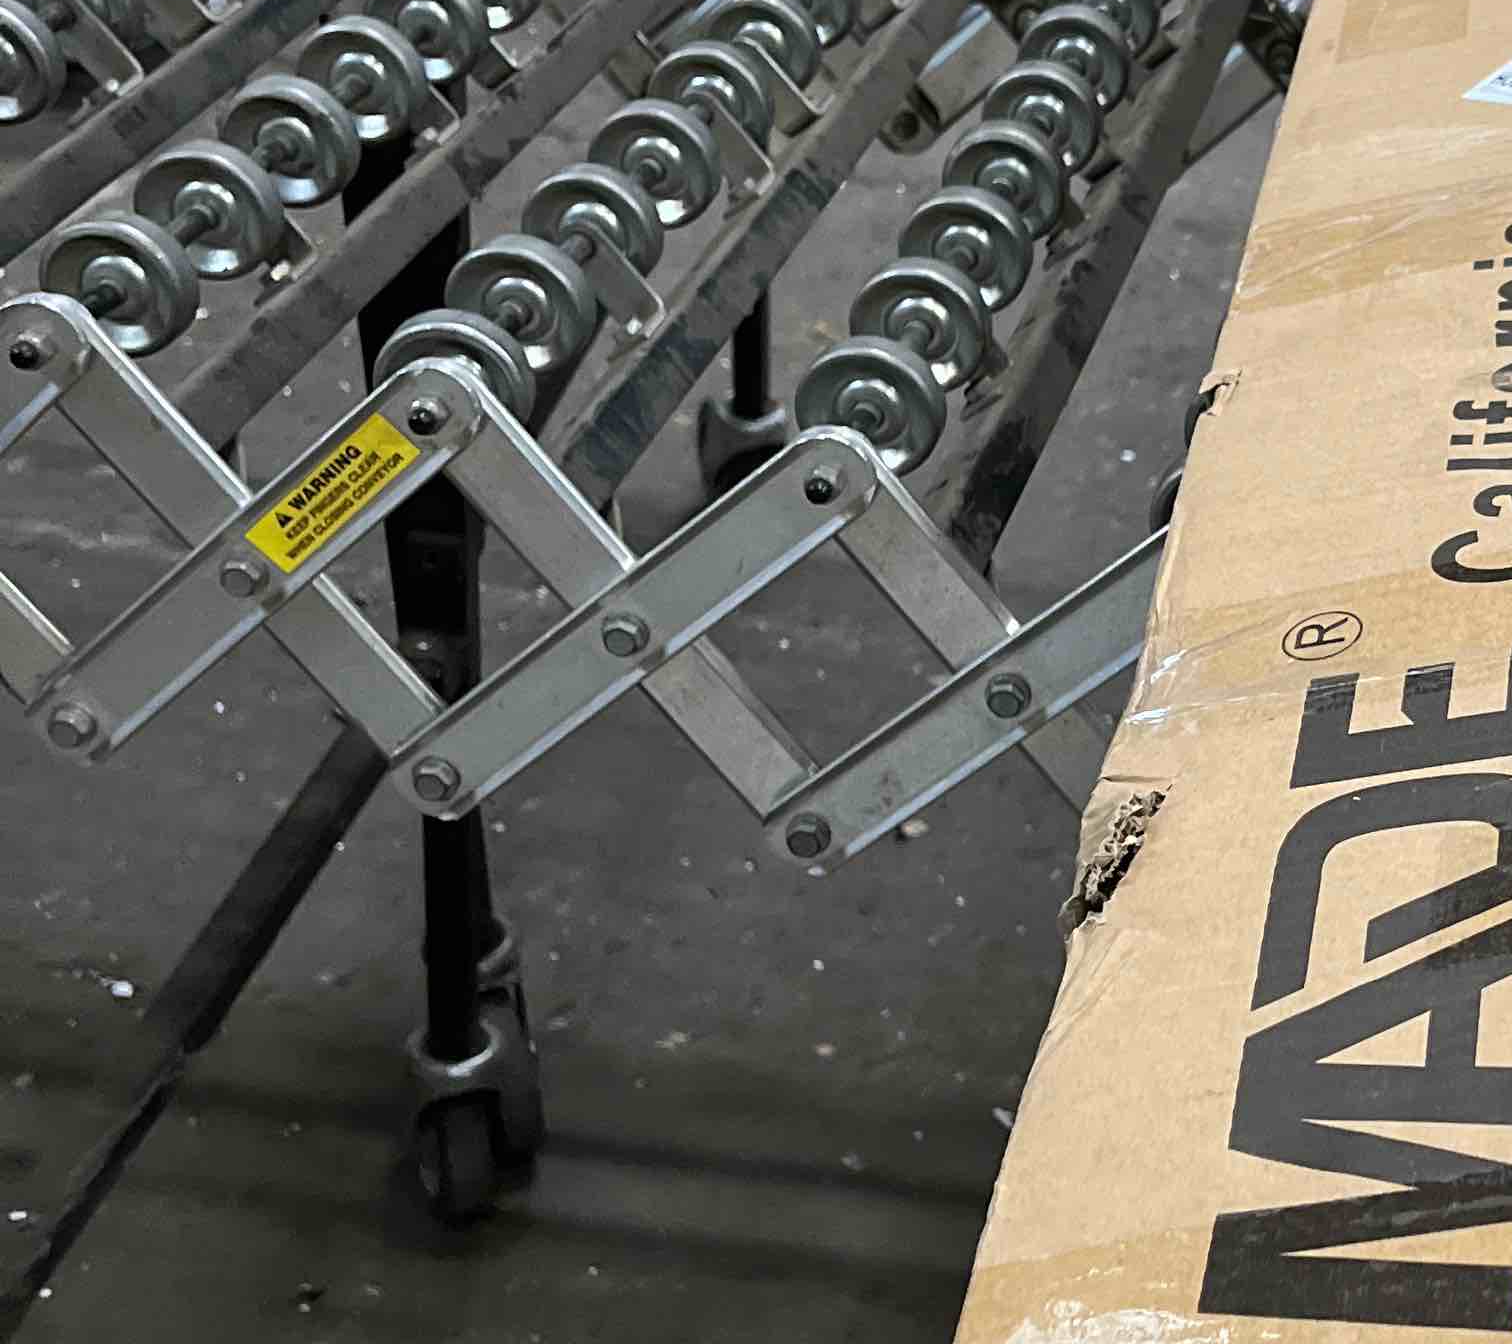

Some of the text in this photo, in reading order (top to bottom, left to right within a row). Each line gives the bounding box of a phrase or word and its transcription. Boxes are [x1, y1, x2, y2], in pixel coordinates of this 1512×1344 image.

[287, 444, 362, 510] WARNING
[347, 450, 381, 483] CLEAR
[351, 451, 404, 501] CONVEYOR
